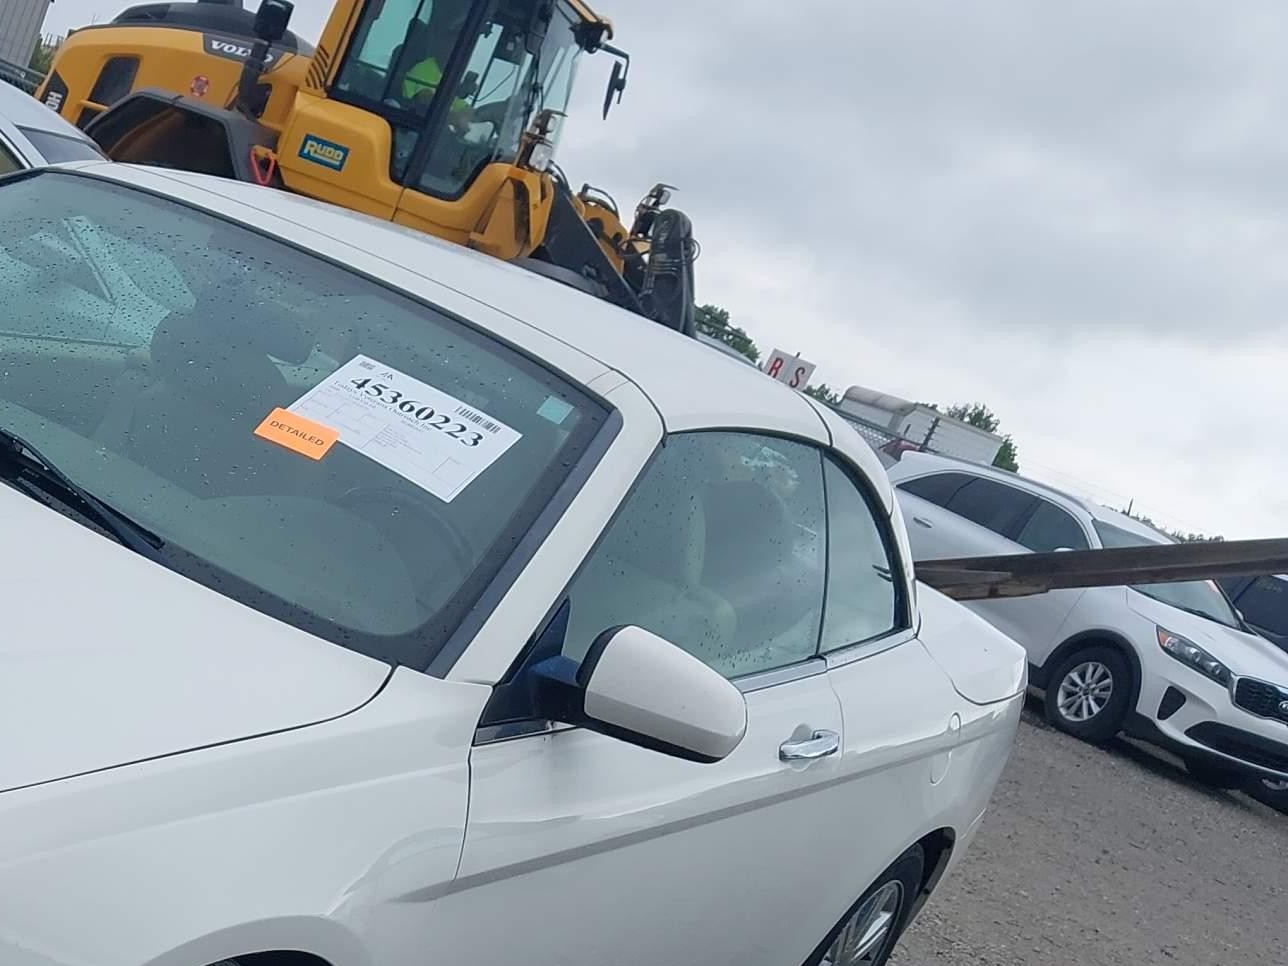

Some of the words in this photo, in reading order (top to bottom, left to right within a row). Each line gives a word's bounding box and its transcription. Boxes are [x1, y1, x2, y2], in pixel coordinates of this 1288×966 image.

[767, 357, 784, 378] R
[789, 366, 805, 388] S
[350, 378, 484, 447] 45360223
[270, 420, 325, 446] DETAILED
